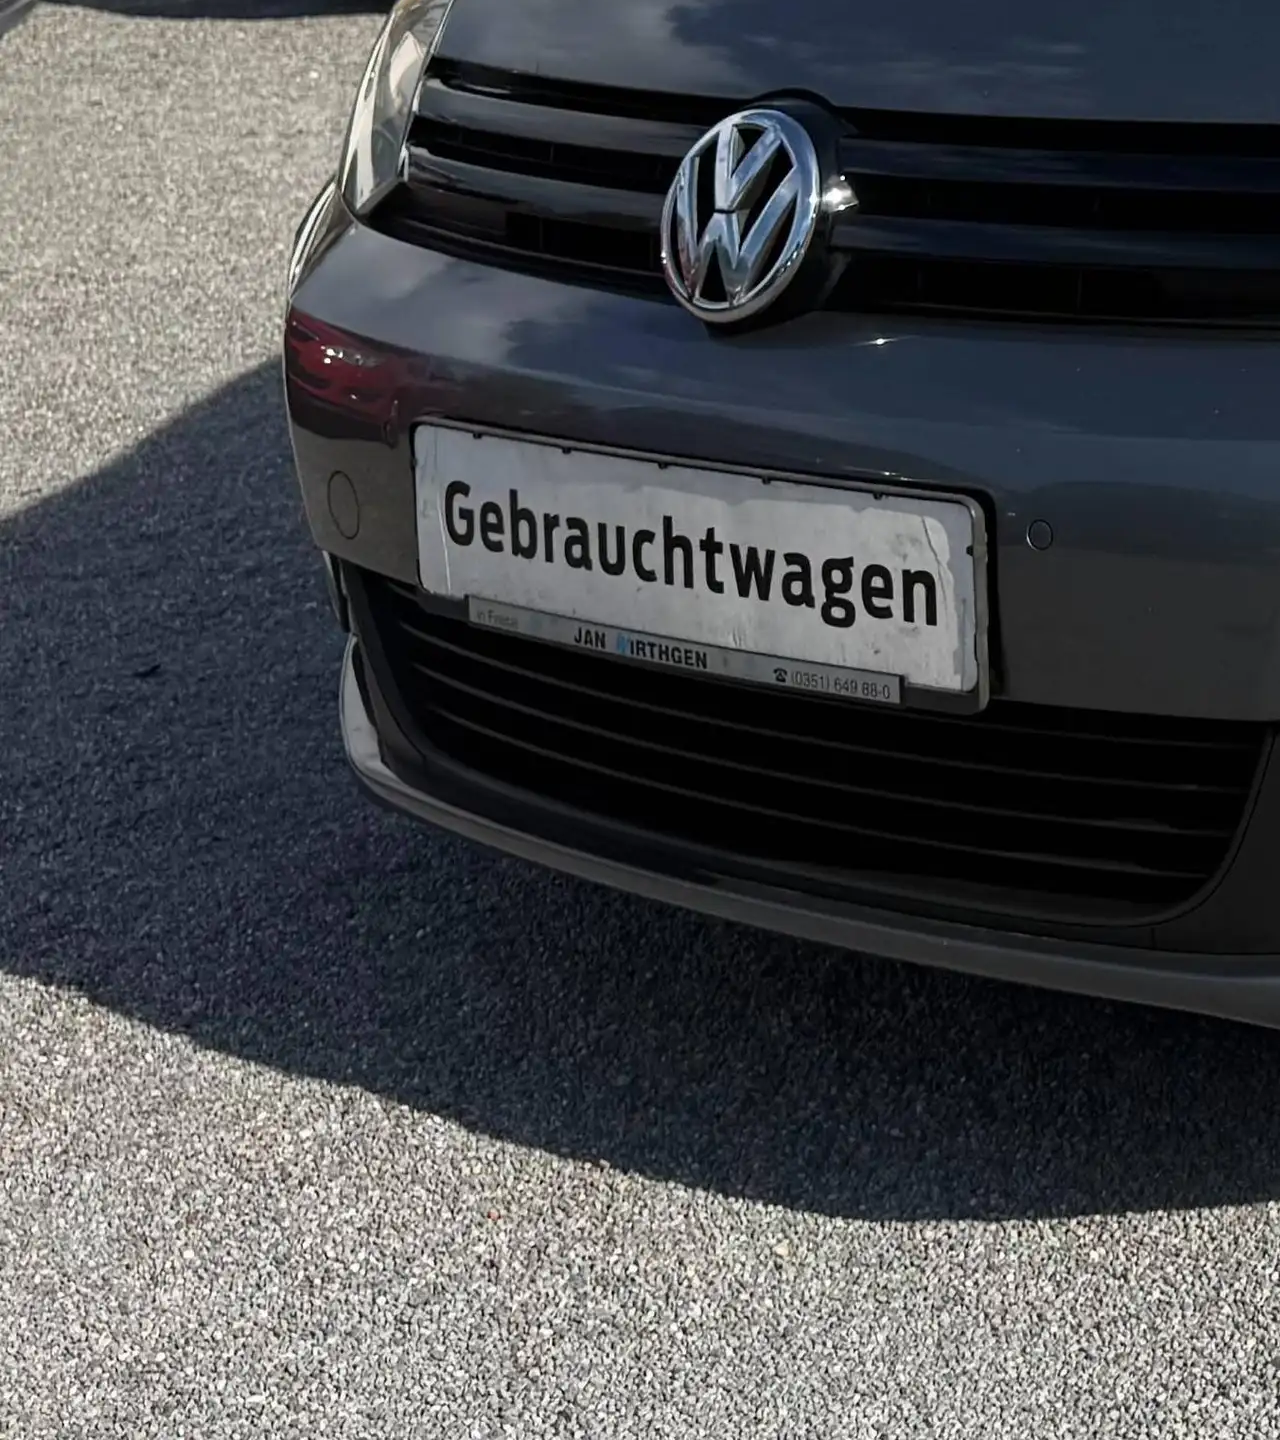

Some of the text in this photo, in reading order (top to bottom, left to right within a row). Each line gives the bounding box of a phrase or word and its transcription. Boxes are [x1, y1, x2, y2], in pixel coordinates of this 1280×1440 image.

[444, 481, 938, 628] Gebrauchtwagen
[574, 627, 708, 670] JAN WIRTHGEN
[791, 671, 830, 690] (0351)
[834, 677, 858, 694] 649
